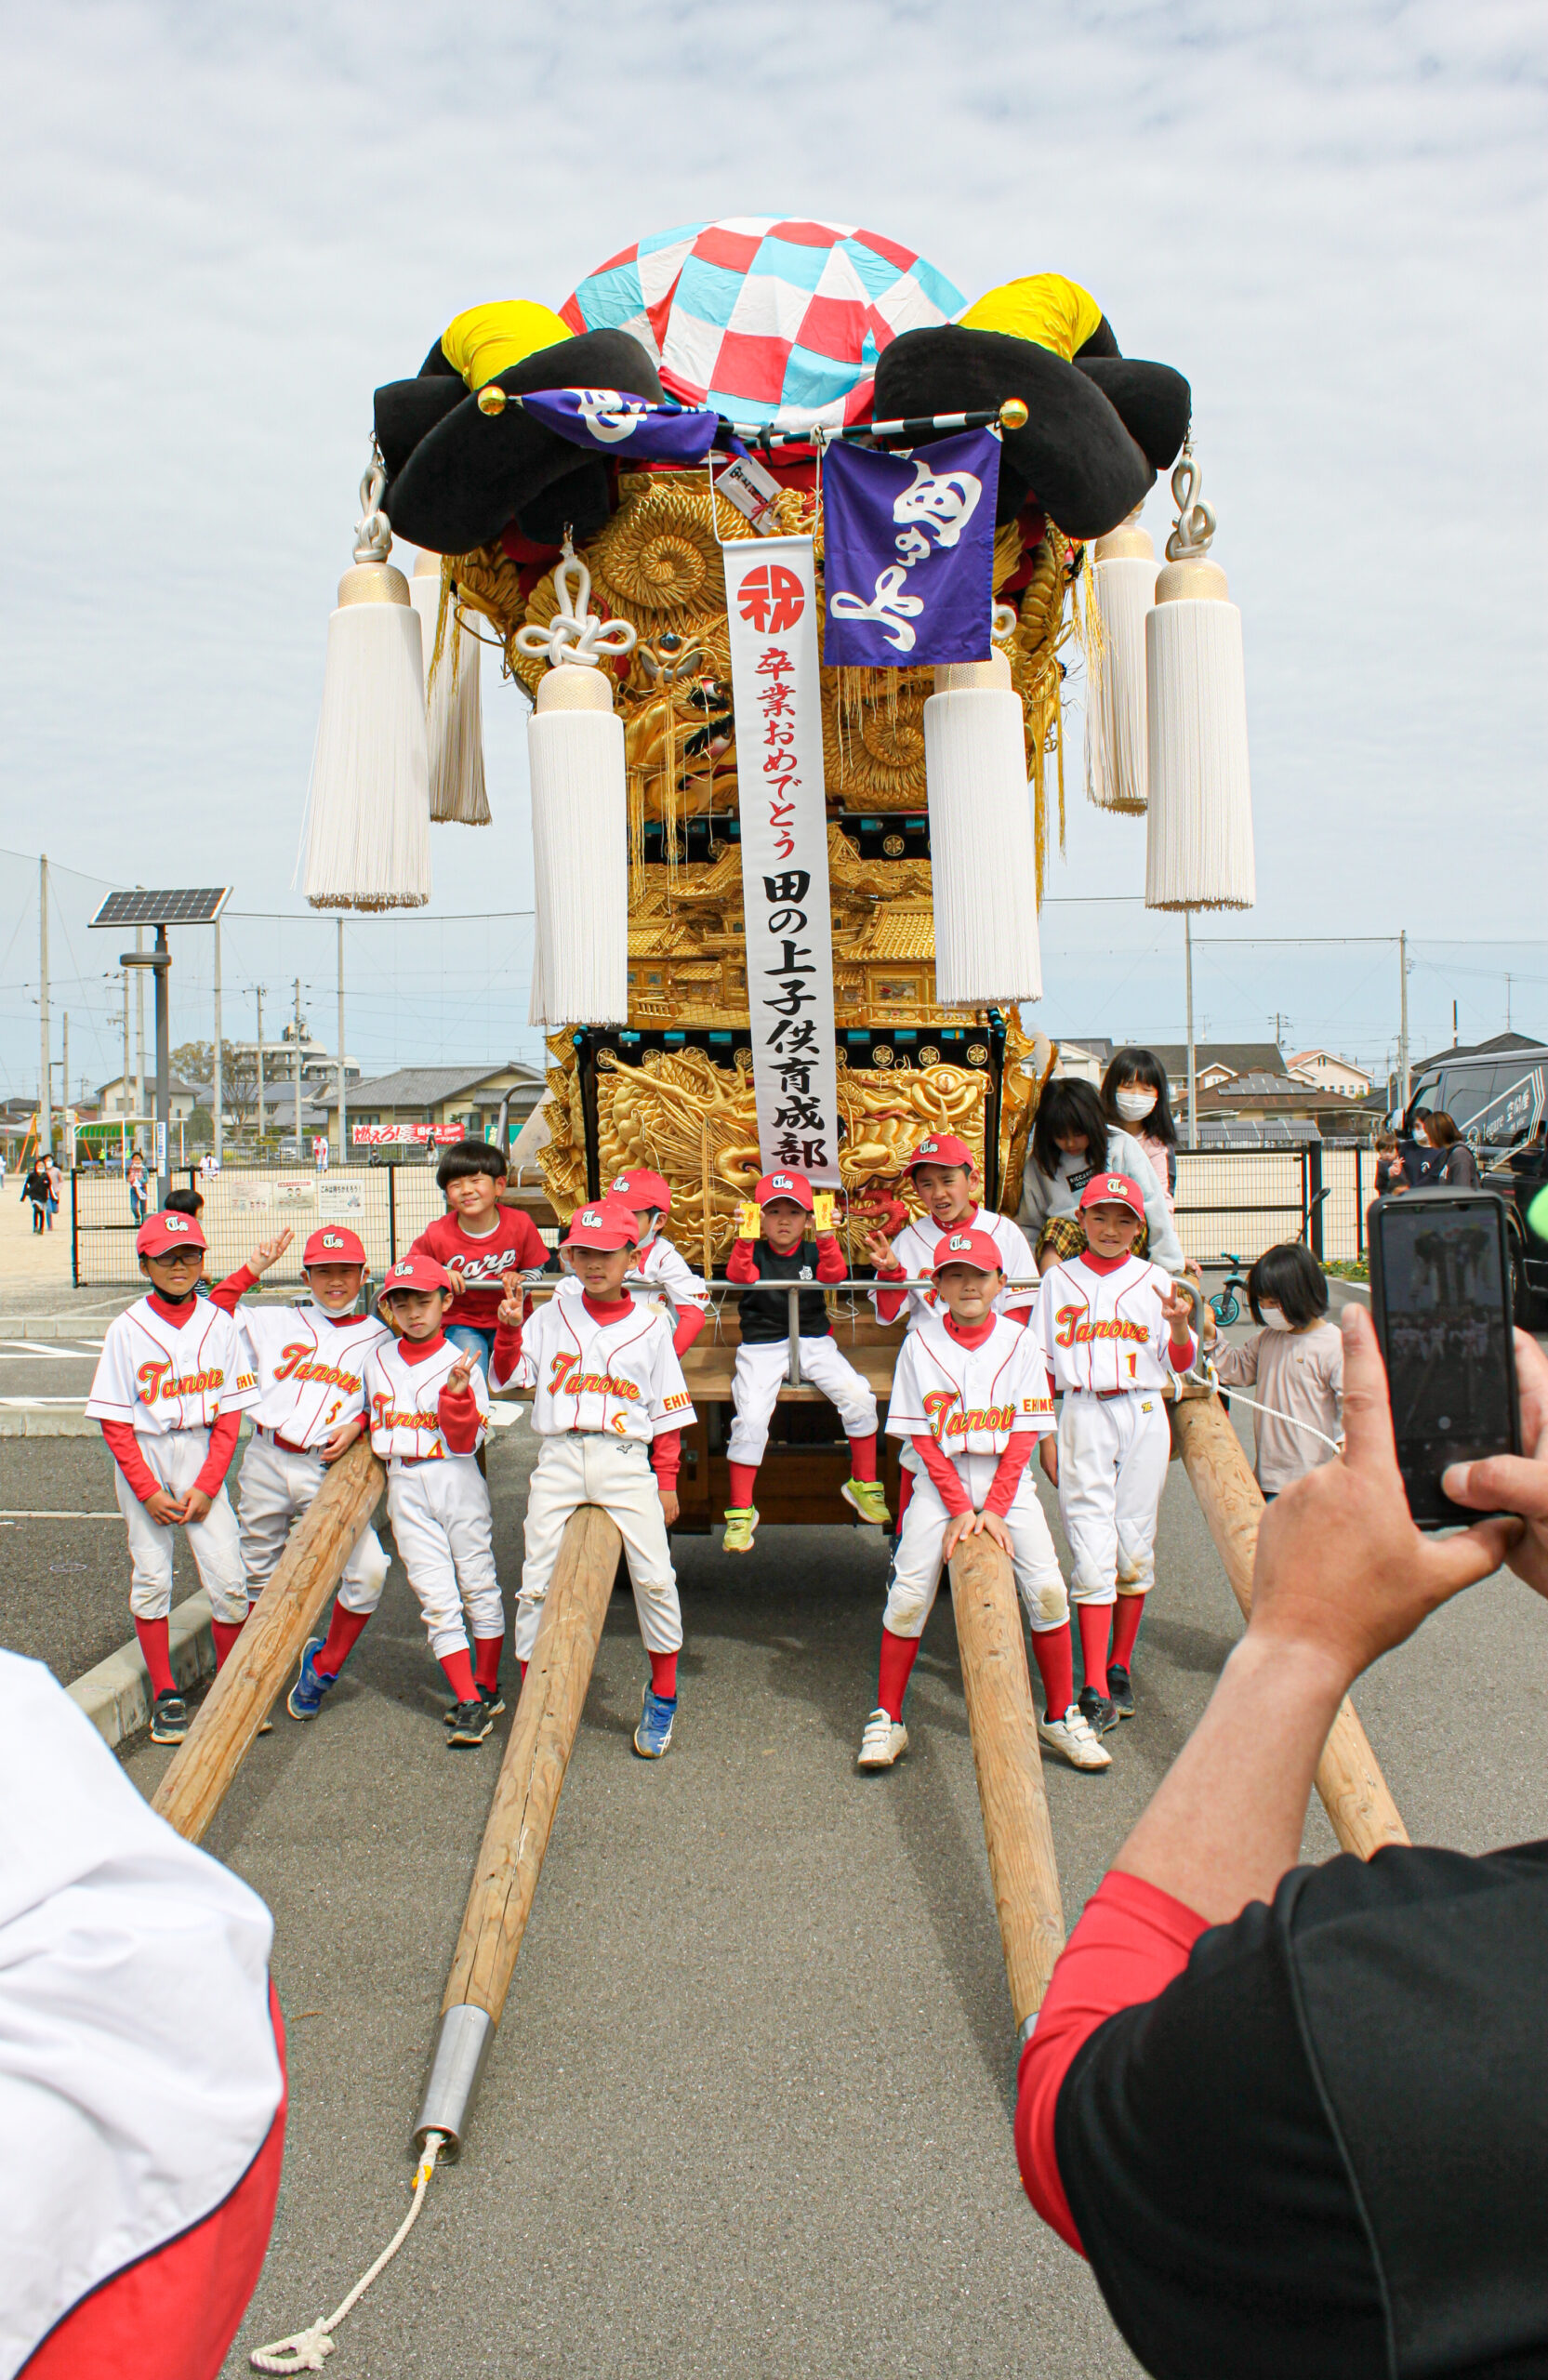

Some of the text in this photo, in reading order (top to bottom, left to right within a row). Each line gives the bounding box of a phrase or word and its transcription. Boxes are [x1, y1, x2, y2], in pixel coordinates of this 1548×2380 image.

[736, 563, 805, 634] 祝
[754, 647, 802, 860] 卒業おめでとう
[761, 869, 828, 1170] 田の上子供育成部
[446, 1249, 516, 1279] Carp
[1055, 1303, 1150, 1350] Tanoue
[547, 1351, 642, 1403] Tanoue
[1126, 1352, 1140, 1380] 1
[325, 1399, 342, 1425] 5
